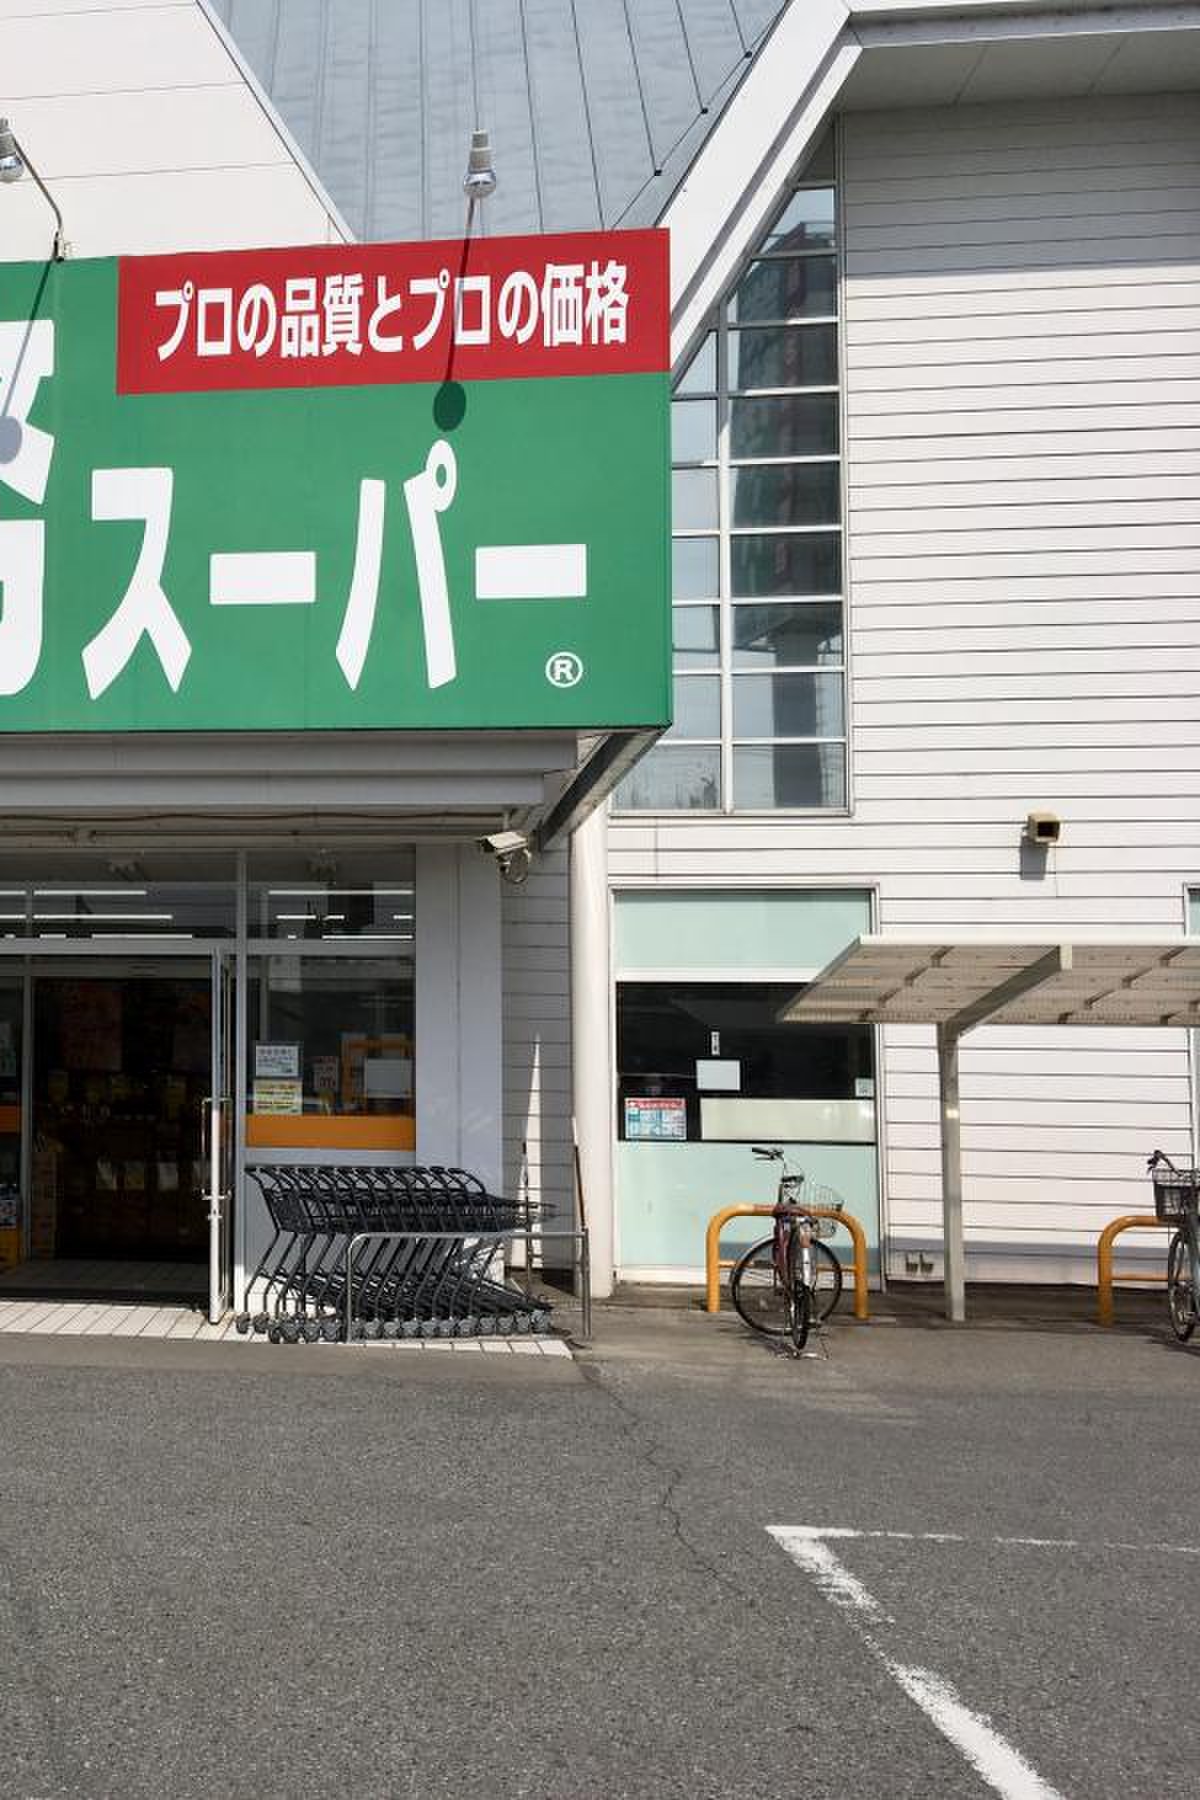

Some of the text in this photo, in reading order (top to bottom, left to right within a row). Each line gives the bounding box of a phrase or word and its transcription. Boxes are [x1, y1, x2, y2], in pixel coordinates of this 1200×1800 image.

[155, 260, 630, 362] プロの品質とプロの価格
